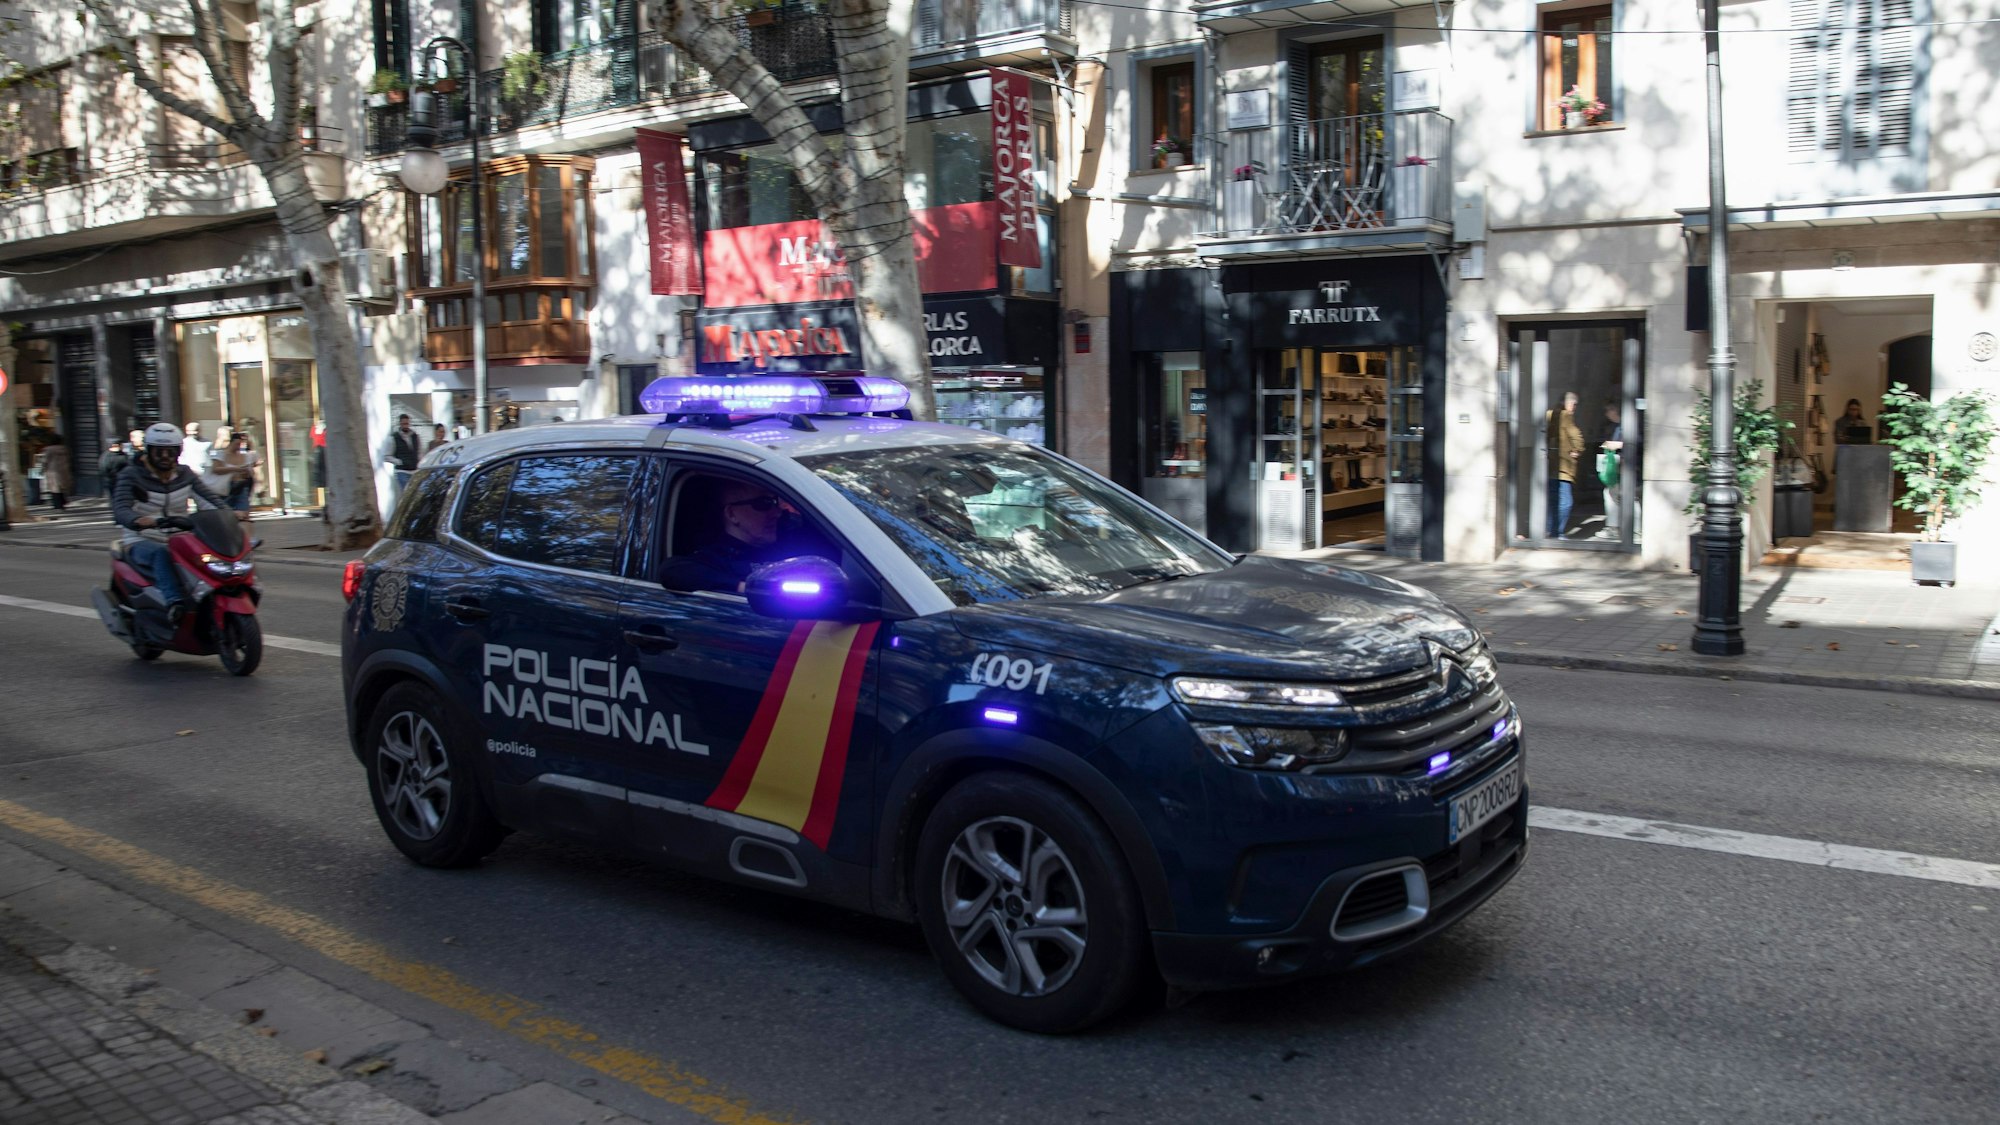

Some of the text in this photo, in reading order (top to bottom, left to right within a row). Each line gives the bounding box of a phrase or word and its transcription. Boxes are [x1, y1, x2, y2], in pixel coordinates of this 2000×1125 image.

[993, 77, 1019, 243] MAJORCA
[1013, 96, 1037, 231] PEARLS
[1288, 306, 1382, 324] FARRUTX
[483, 643, 649, 704] POLICÍA
[985, 654, 1053, 695] 091
[483, 680, 710, 756] NACIONAL
[486, 739, 537, 758] @policia
